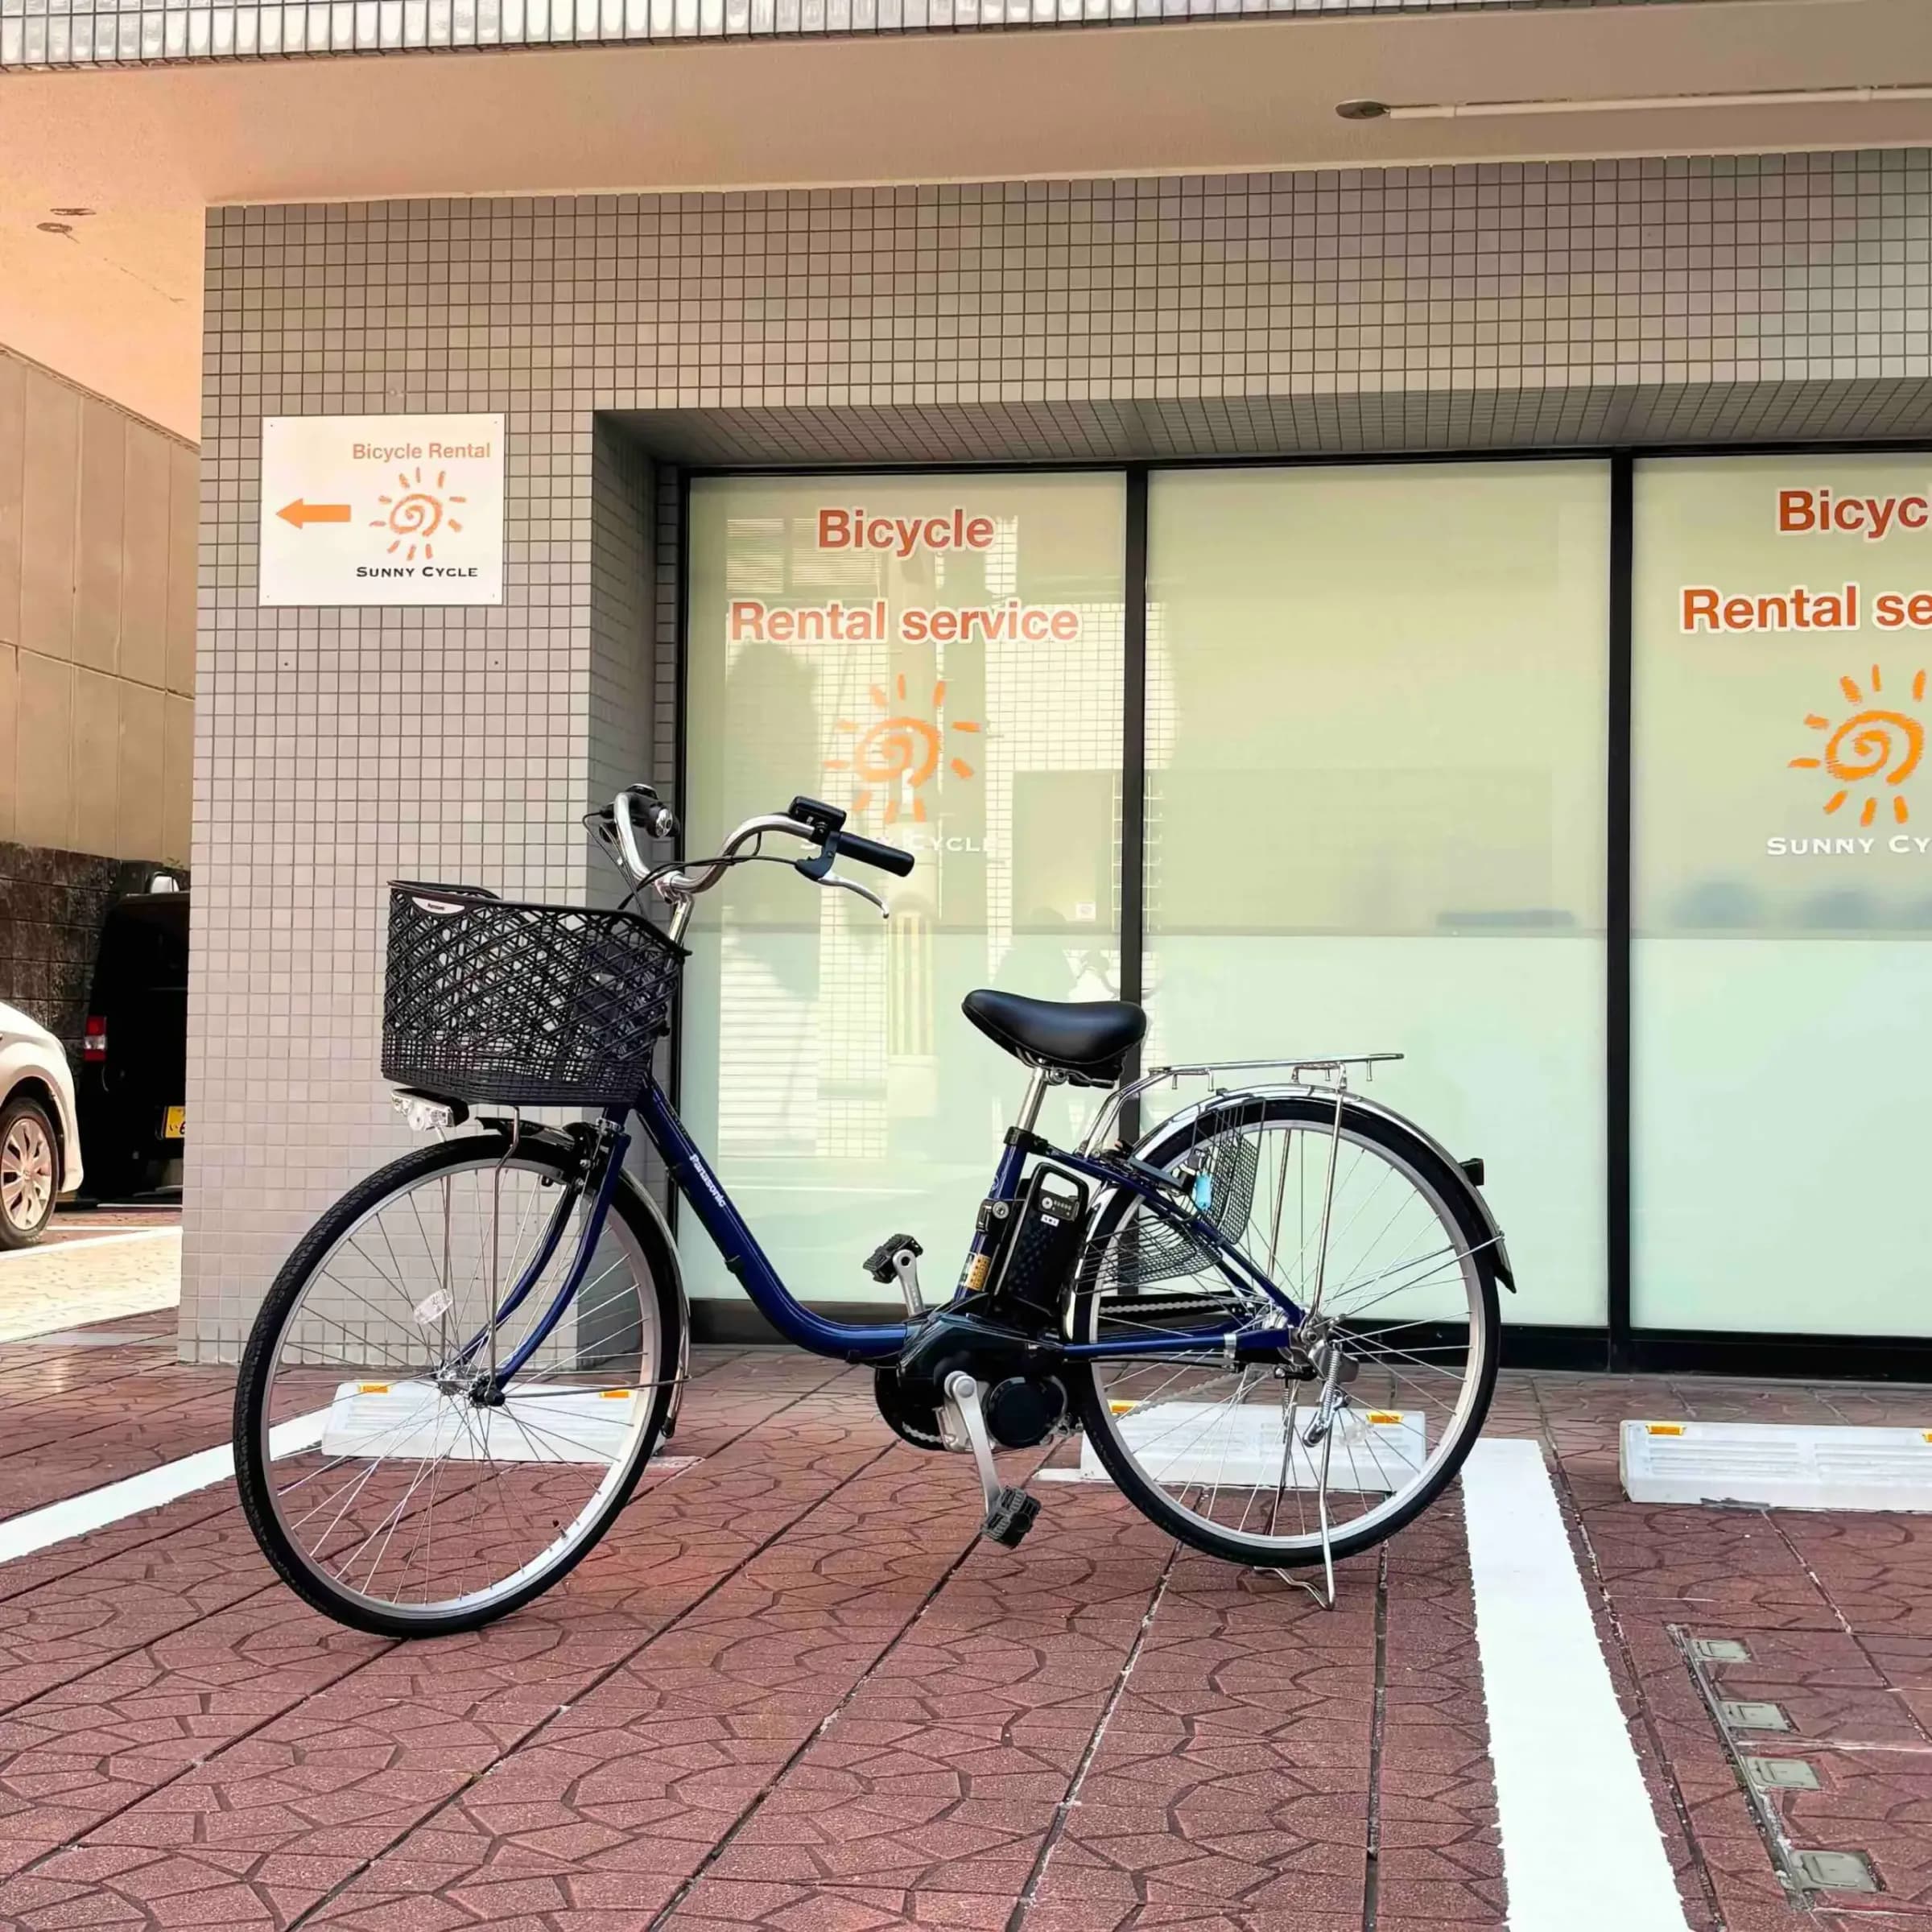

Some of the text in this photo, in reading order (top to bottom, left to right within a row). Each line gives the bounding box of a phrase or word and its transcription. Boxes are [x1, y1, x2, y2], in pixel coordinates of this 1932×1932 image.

[353, 442, 491, 462] Bicycle Rental
[818, 508, 995, 557] Bicycle
[356, 566, 478, 578] SUNNY CYCLE
[731, 600, 1080, 642] Rental service
[1683, 585, 1856, 630] Rental
[1766, 836, 1875, 856] SUNNY
[689, 1154, 726, 1208] Panasonic
